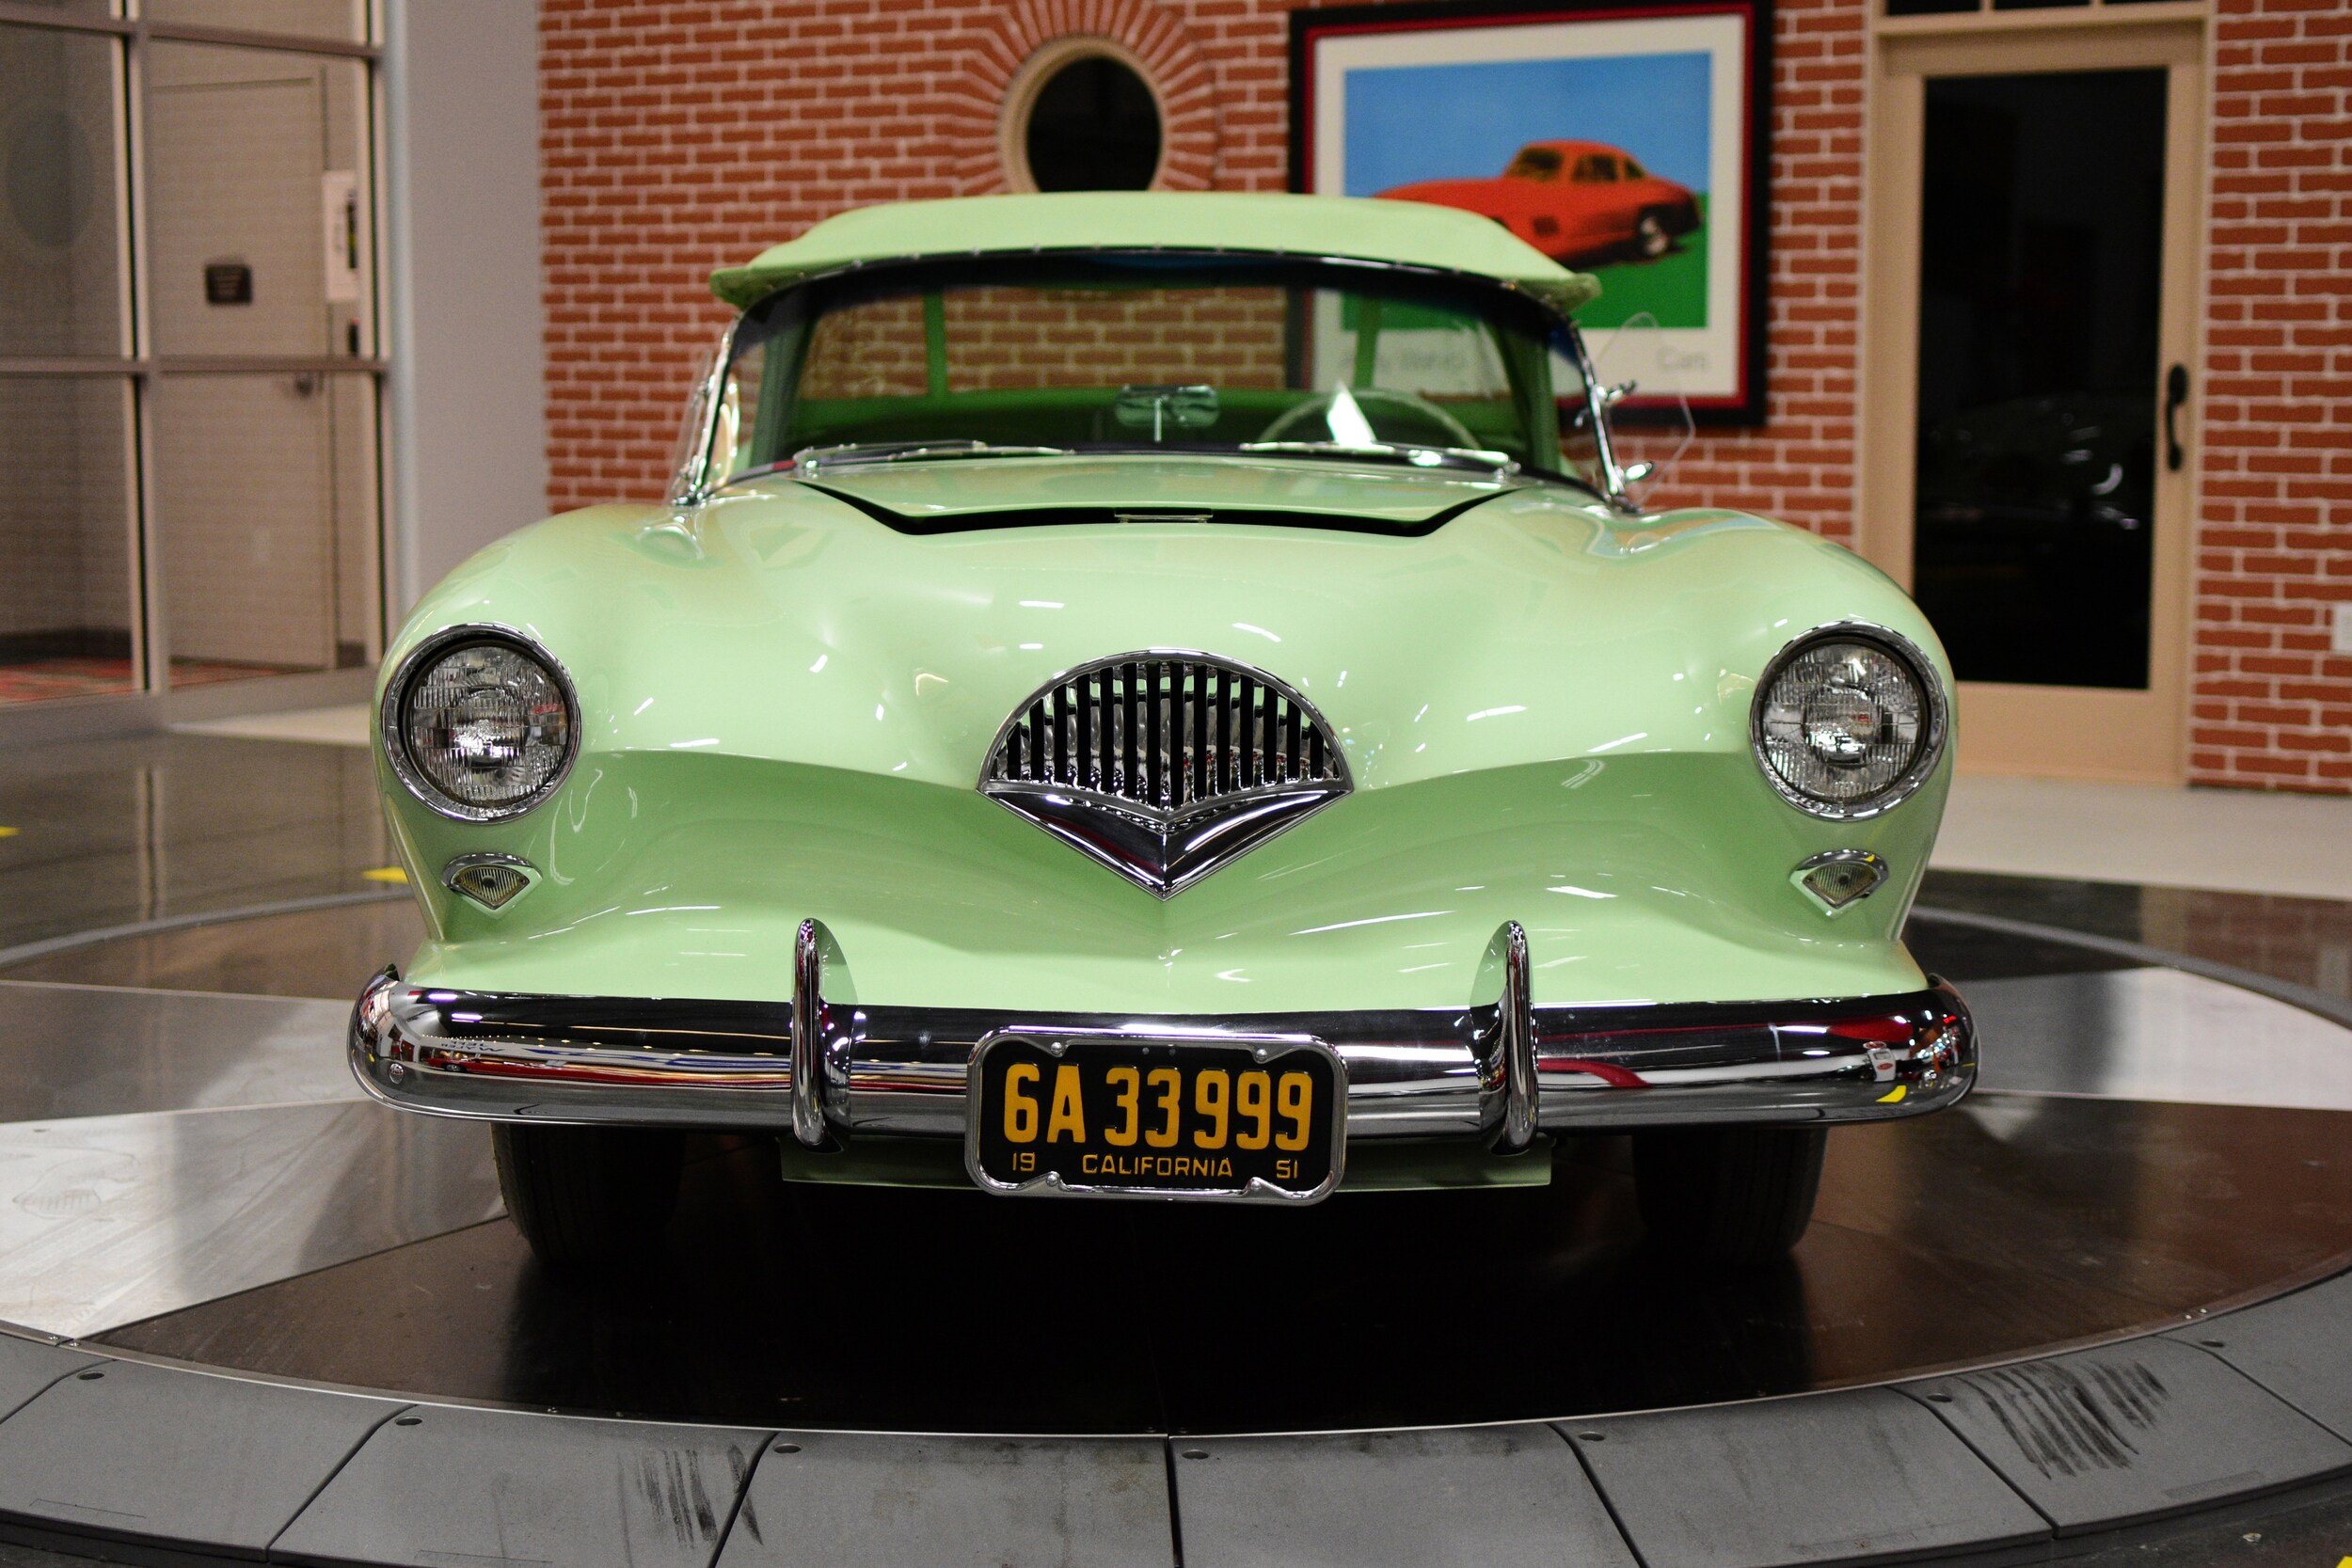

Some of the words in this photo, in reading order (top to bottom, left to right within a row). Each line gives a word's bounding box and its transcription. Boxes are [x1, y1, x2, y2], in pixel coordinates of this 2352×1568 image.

[1004, 1062, 1087, 1144] 6A
[1012, 1152, 1036, 1172] 19
[1082, 1153, 1232, 1178] CALIFORNIA
[1276, 1160, 1298, 1180] 51
